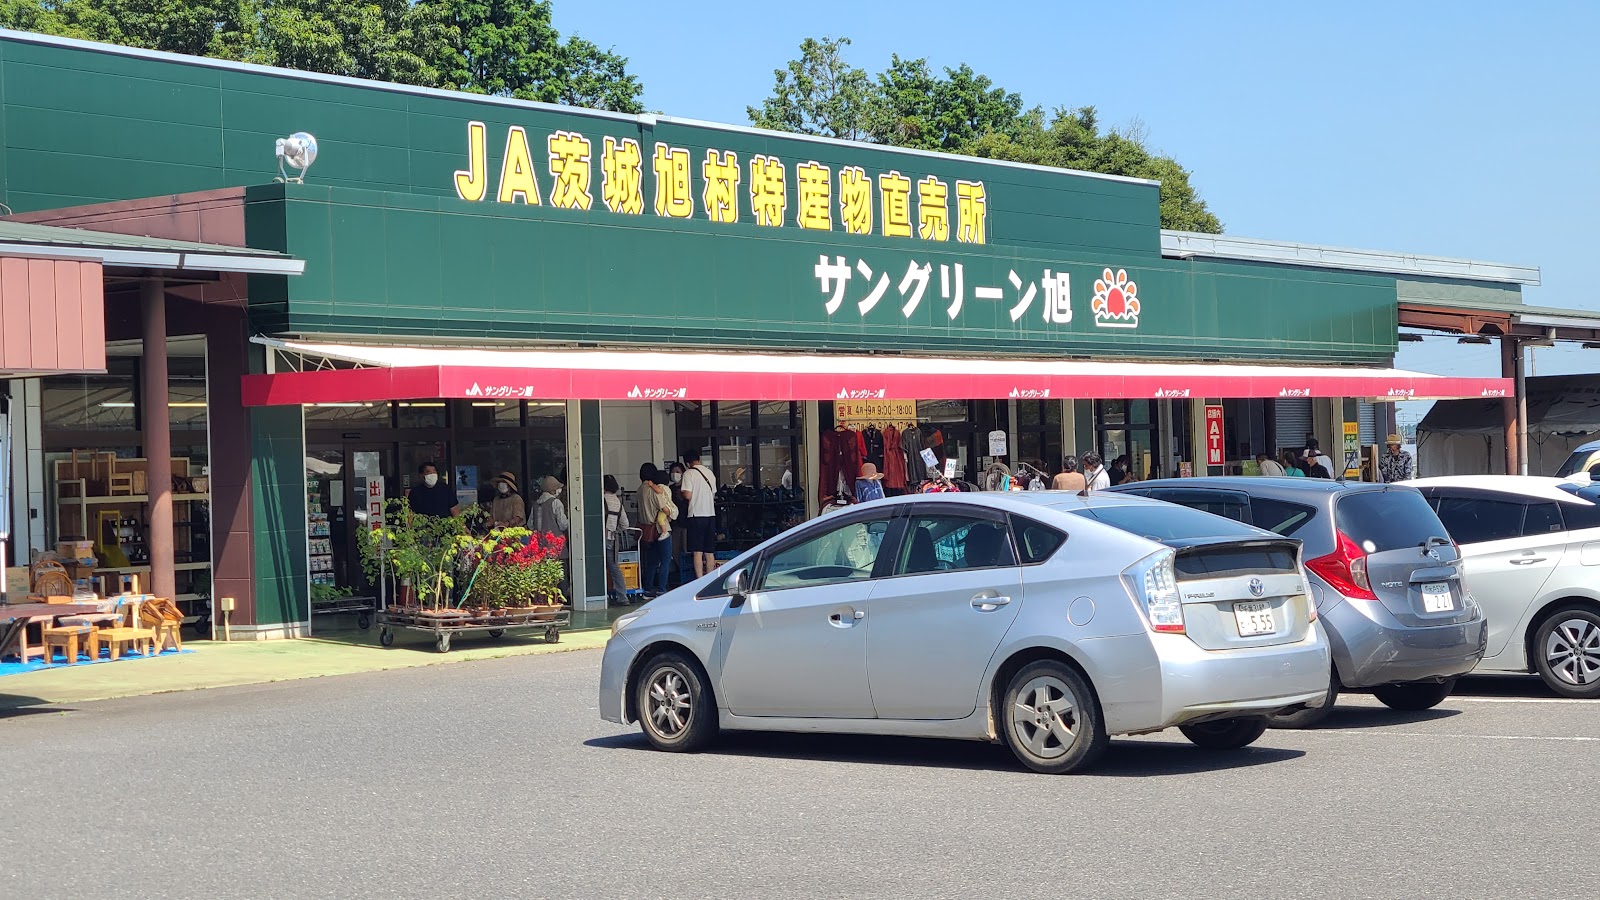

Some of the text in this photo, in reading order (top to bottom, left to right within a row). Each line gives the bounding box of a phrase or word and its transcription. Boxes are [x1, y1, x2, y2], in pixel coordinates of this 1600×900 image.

[454, 121, 986, 245] JA茨城旭村特産物直売所
[814, 255, 1073, 324] サングリーン旭
[1210, 420, 1221, 463] ATM
